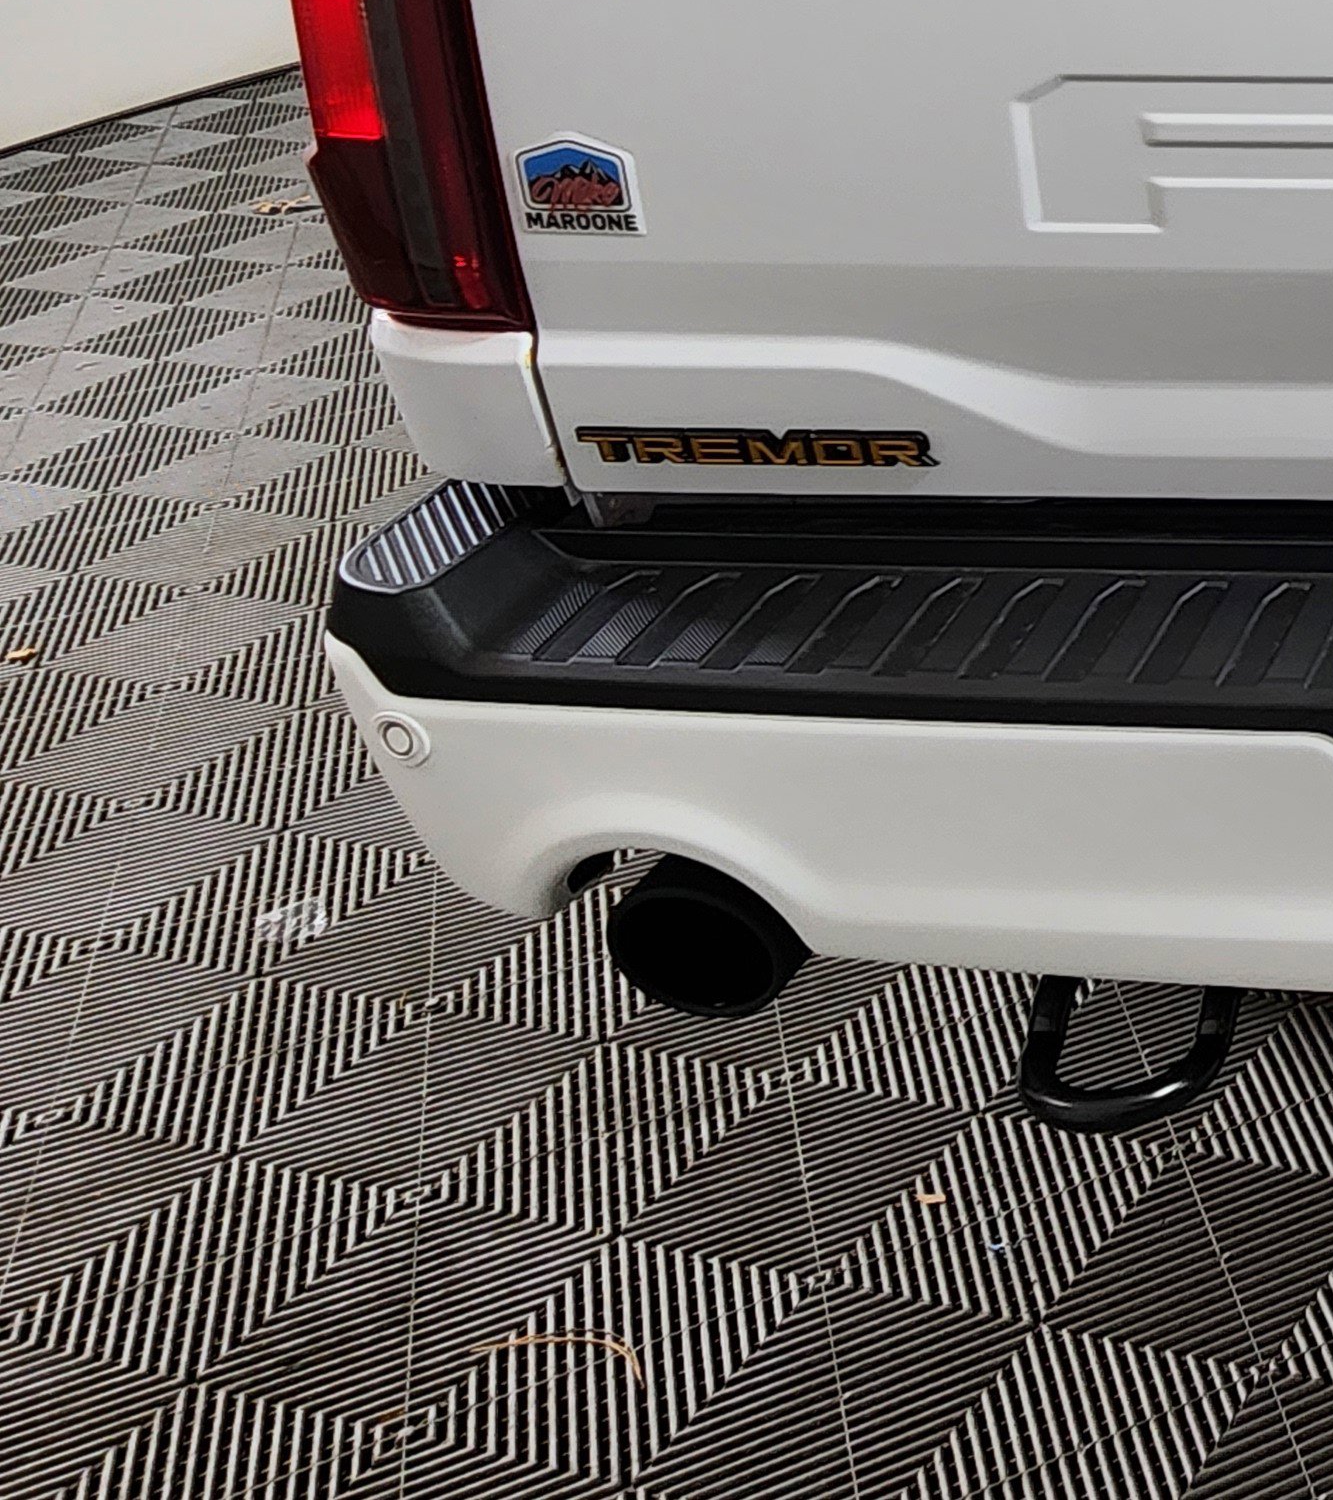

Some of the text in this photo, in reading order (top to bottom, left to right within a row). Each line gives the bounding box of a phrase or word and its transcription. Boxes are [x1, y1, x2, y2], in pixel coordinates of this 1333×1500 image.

[532, 174, 622, 213] Mike
[525, 211, 639, 232] MAROONE
[575, 426, 941, 467] TREMOR
